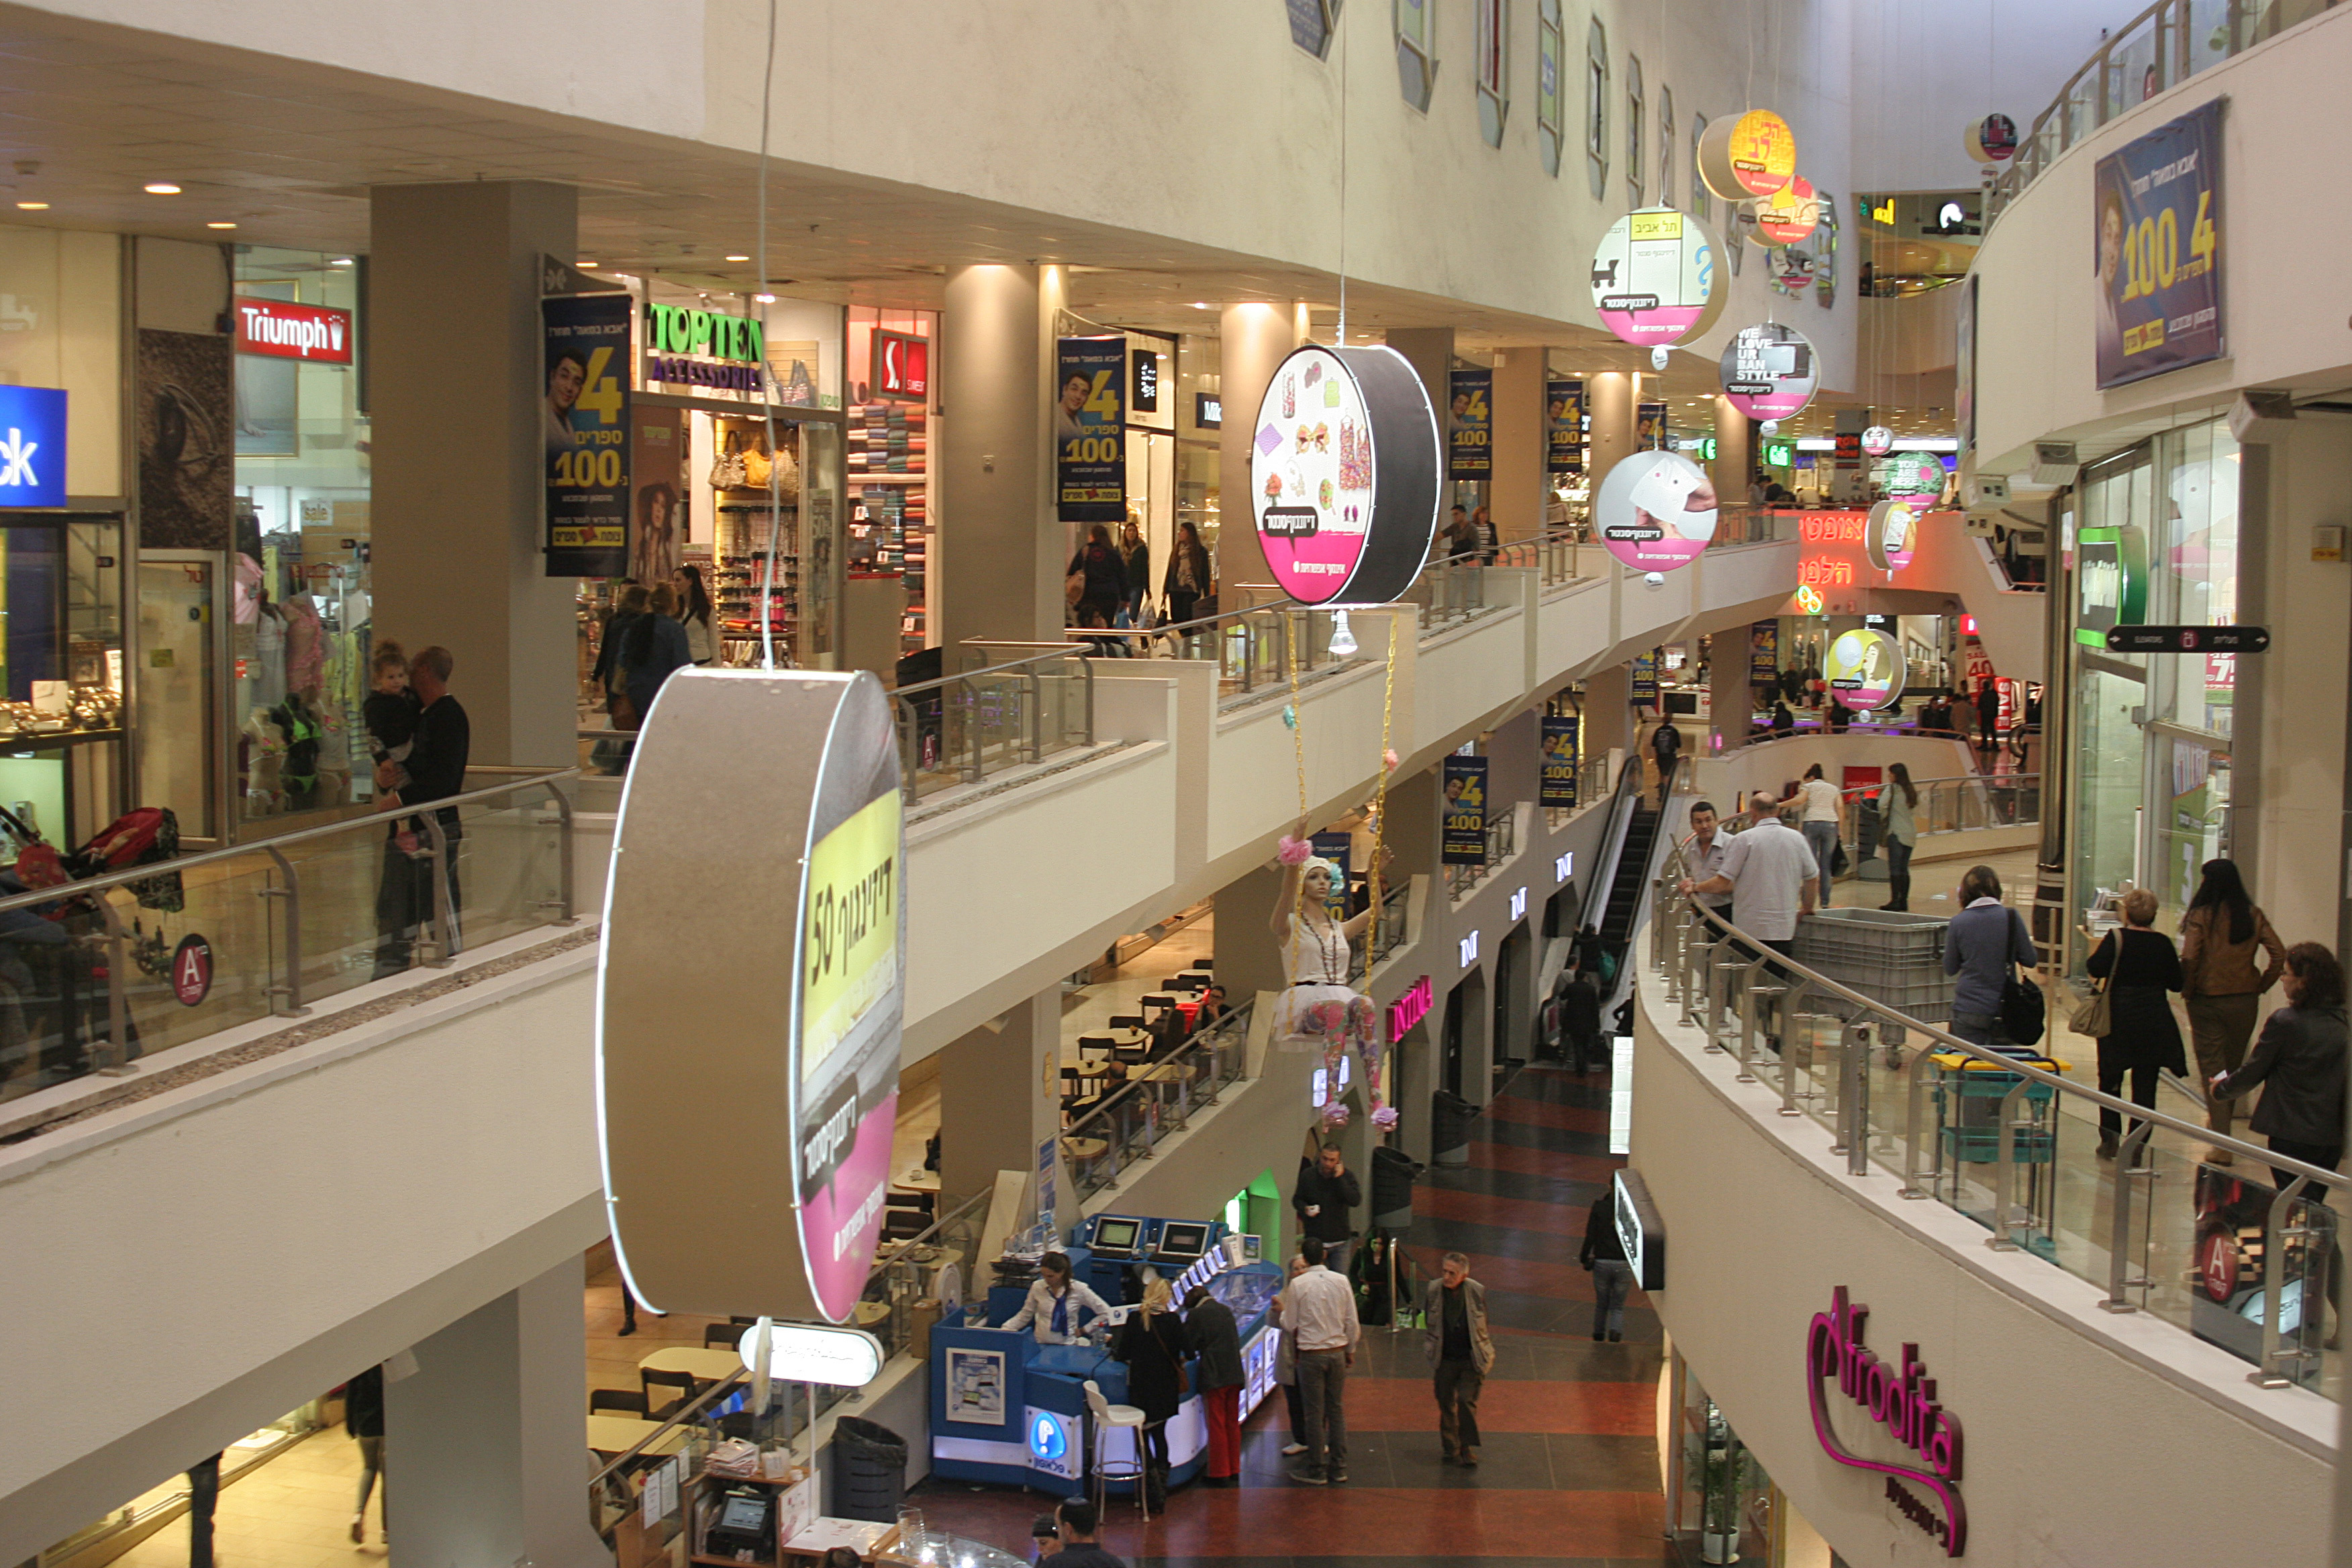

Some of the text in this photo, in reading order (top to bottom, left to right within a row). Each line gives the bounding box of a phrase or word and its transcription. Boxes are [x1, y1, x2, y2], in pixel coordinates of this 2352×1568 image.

[1635, 220, 1677, 234] תל אביב
[2190, 190, 2216, 273] 4
[242, 307, 328, 356] Triumph
[1738, 328, 1759, 338] WE
[1738, 338, 1773, 349] LOVE
[1737, 349, 1757, 360] UR
[575, 346, 623, 424] 4
[1083, 370, 1120, 421] 4
[1465, 389, 1489, 421] 4
[1560, 397, 1581, 424] 4
[575, 430, 623, 445] ספרים
[1083, 425, 1120, 434] ספרים
[1761, 631, 1777, 651] 4
[1998, 681, 2011, 727] SALE
[1553, 733, 1575, 758] 4
[1459, 775, 1484, 806] 4
[812, 883, 834, 987] 50
[183, 948, 201, 985] A
[2208, 1237, 2226, 1280] A
